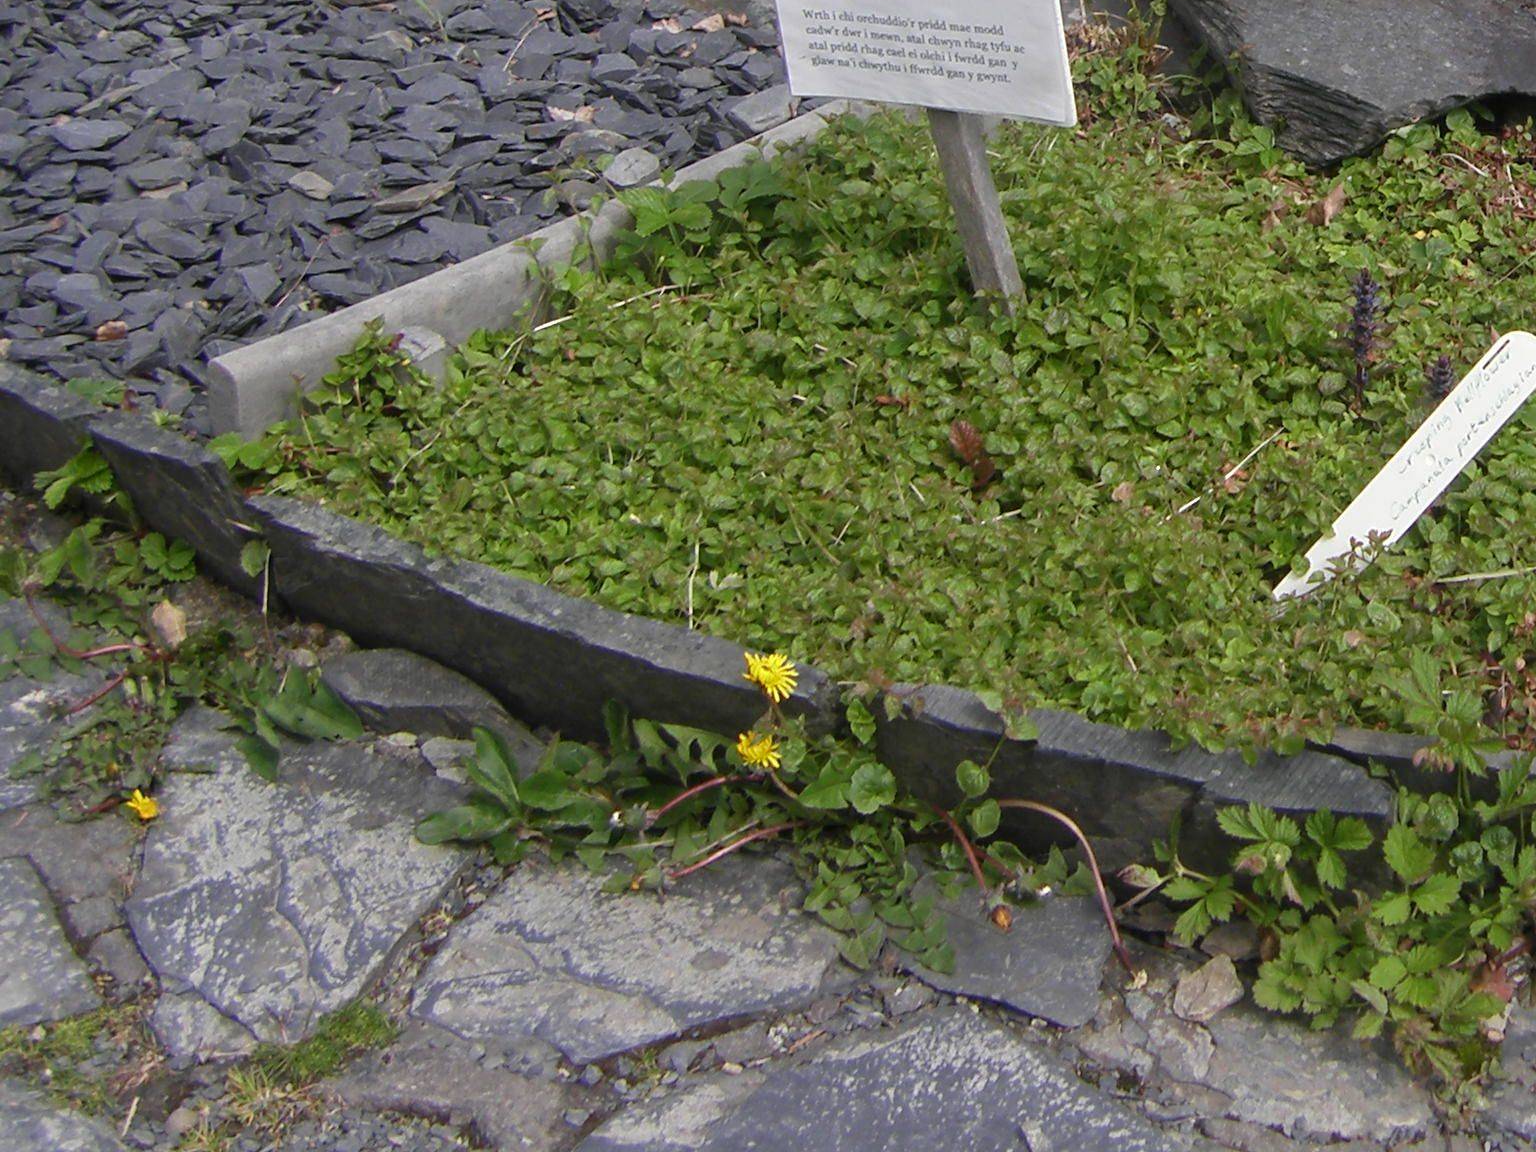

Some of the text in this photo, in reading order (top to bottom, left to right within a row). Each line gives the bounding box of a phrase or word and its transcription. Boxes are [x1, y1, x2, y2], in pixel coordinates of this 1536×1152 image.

[803, 10, 830, 20] Wrth
[839, 11, 854, 21] chi
[917, 19, 947, 31] pridd
[949, 23, 971, 32] mae
[974, 24, 1004, 35] modd
[808, 40, 827, 51] atal
[830, 41, 858, 54] pridd
[860, 43, 885, 57] rhag
[886, 48, 905, 57] cael
[908, 48, 917, 58] ei
[920, 50, 946, 60] olchi
[988, 59, 1007, 68] gan
[906, 33, 925, 44] atal
[928, 35, 962, 48] chwyn
[964, 36, 989, 51] rhag
[990, 41, 1012, 53] tyfu
[1014, 44, 1025, 53] ac
[811, 56, 835, 67] glaw
[858, 59, 902, 73] chwythu
[909, 62, 944, 77] ffwrdd
[946, 69, 965, 80] gan
[977, 72, 1011, 83] gwynt.
